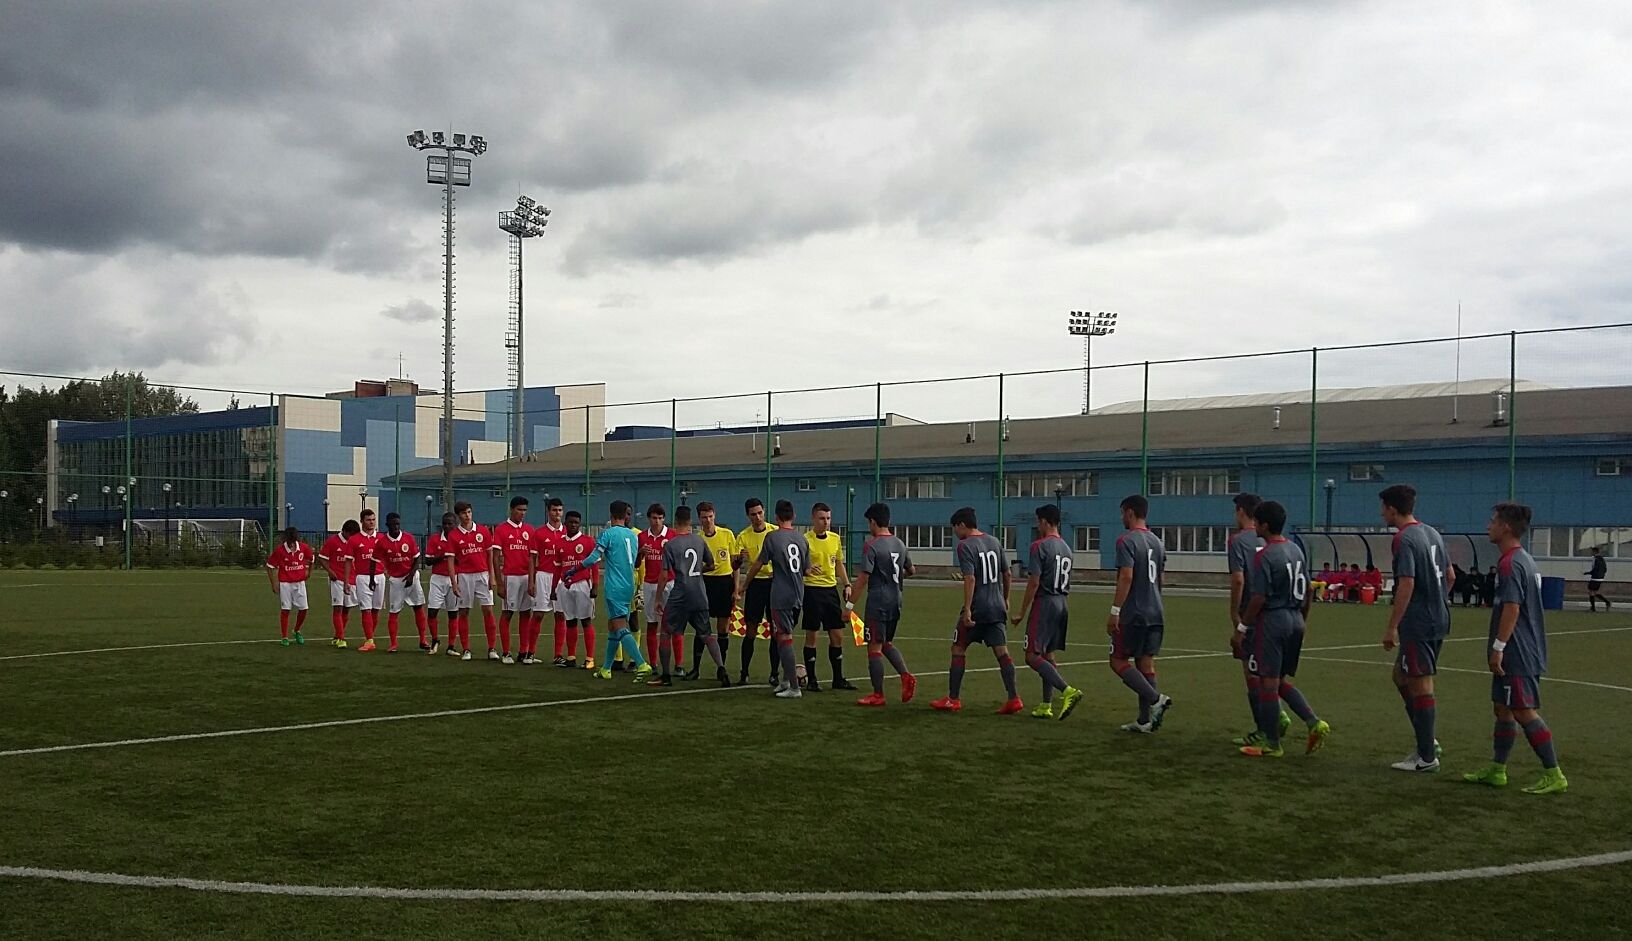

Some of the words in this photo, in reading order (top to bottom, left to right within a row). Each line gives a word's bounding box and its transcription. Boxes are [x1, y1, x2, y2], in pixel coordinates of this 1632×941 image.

[624, 538, 633, 564] 1
[685, 548, 701, 577] 2
[787, 543, 801, 573] 8
[1430, 544, 1443, 587] 4
[890, 552, 900, 584] 3
[978, 551, 998, 585] 10
[1148, 549, 1157, 584] 6
[1286, 561, 1306, 600] 16
[865, 627, 871, 641] 3
[1248, 654, 1258, 671] 6
[1402, 655, 1409, 672] 4
[1503, 685, 1511, 706] 7
